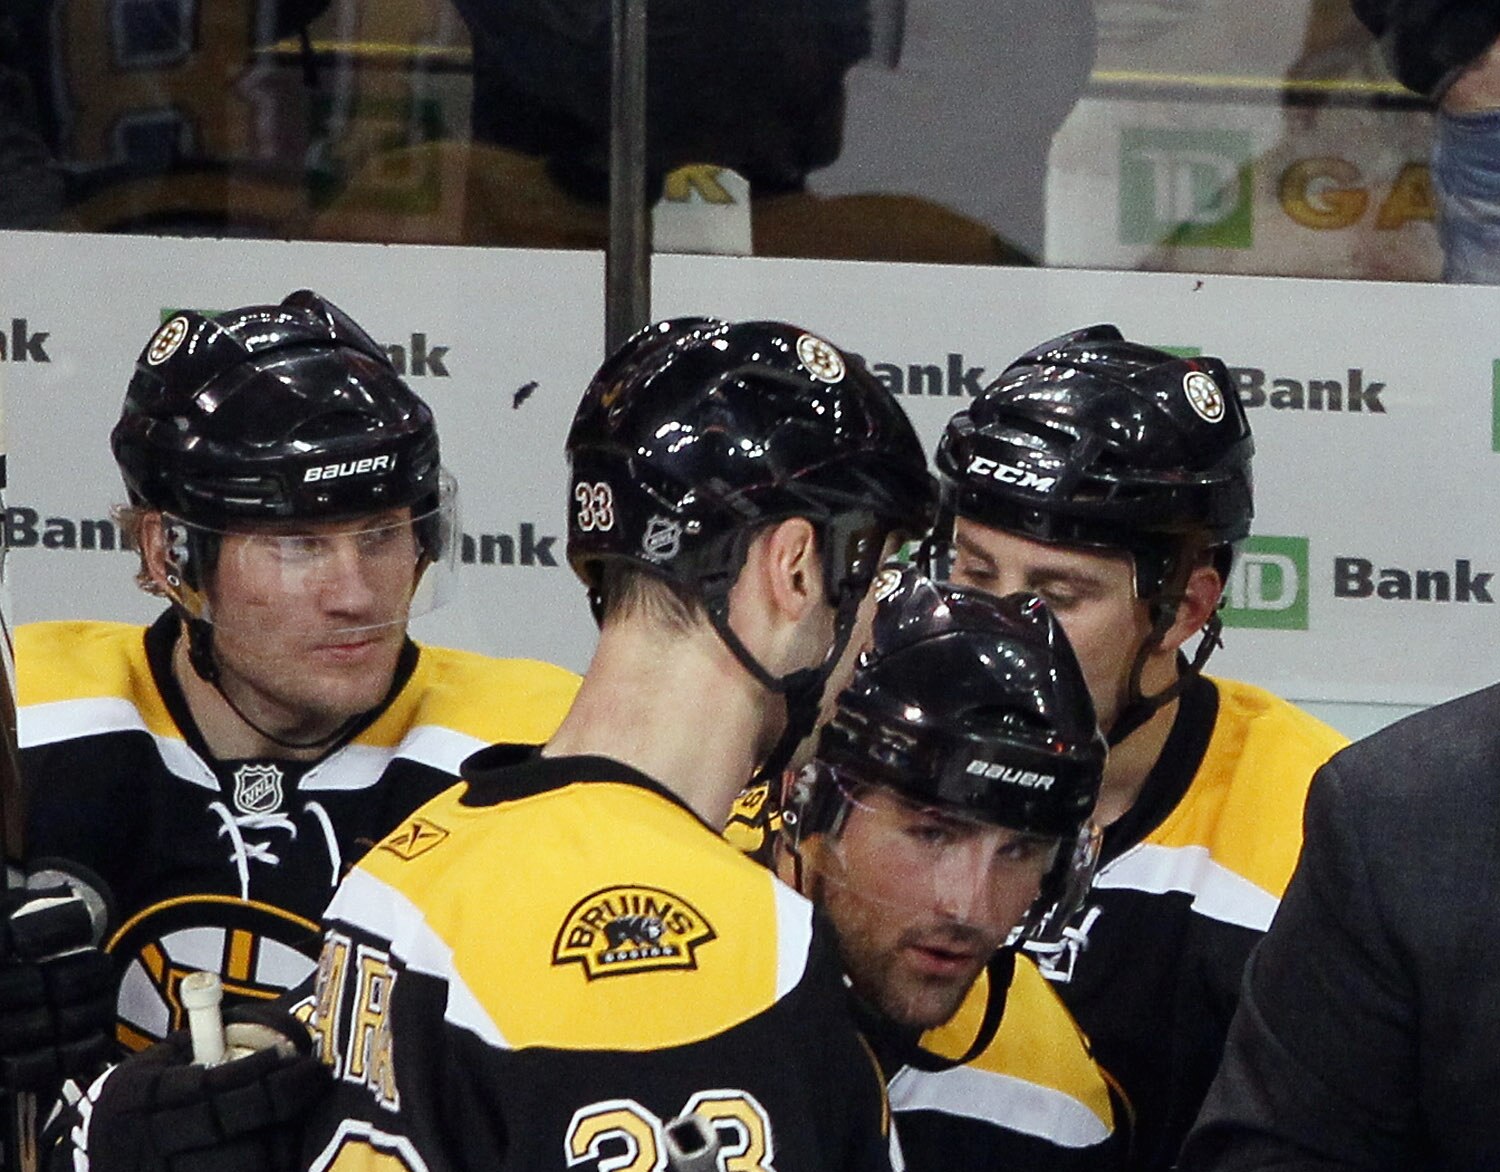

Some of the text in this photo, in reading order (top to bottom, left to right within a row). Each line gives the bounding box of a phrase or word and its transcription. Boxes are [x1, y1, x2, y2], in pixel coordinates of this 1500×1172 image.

[1233, 367, 1388, 414] Bank
[304, 455, 390, 482] BAUER
[966, 455, 1056, 493] CCM
[575, 481, 614, 532] 33
[1334, 557, 1494, 604] Bank
[966, 759, 1056, 791] BAUER
[567, 895, 694, 951] BRUINS
